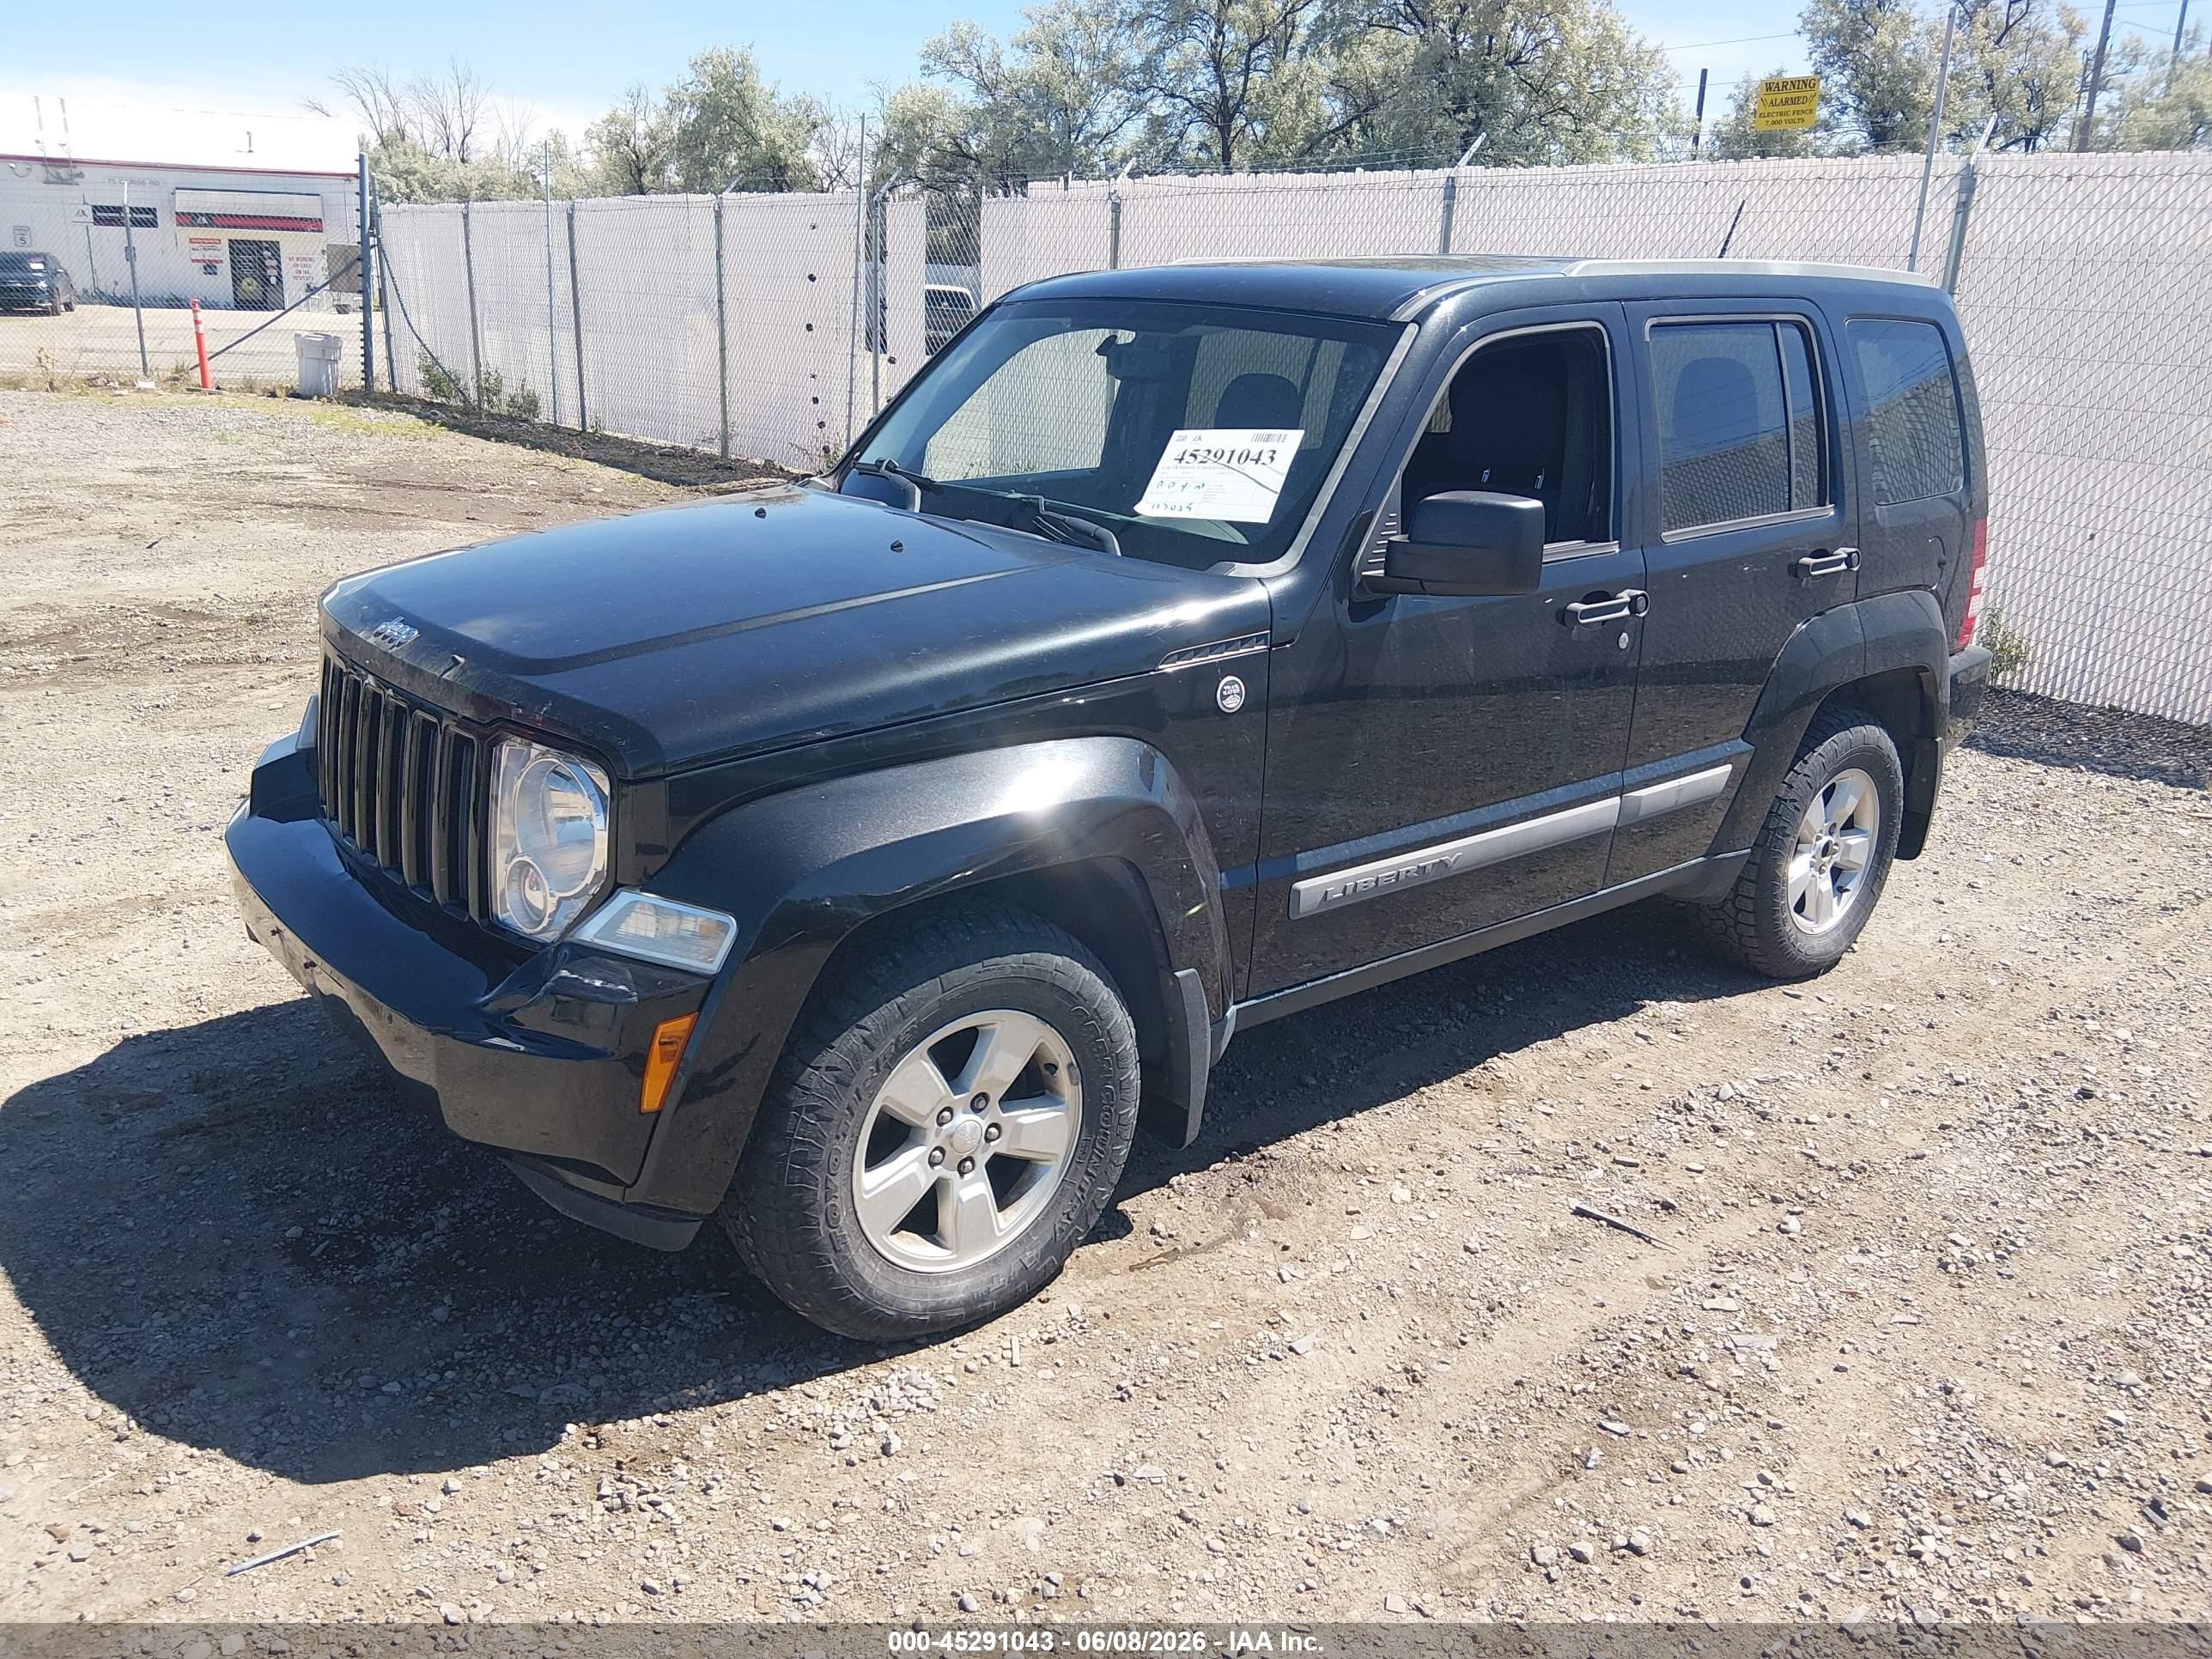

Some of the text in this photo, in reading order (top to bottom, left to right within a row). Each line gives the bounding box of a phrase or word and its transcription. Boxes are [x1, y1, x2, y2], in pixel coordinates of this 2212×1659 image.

[1765, 78, 1816, 93] WARNING
[1768, 95, 1808, 107] ALARMED
[1759, 110, 1790, 118] ELECTRIC
[20, 236, 27, 246] 5
[1173, 448, 1278, 465] 45291043
[1324, 852, 1464, 901] LIBERTY
[1054, 1084, 1117, 1243] COUNTRY
[825, 1145, 848, 1253] TOYO
